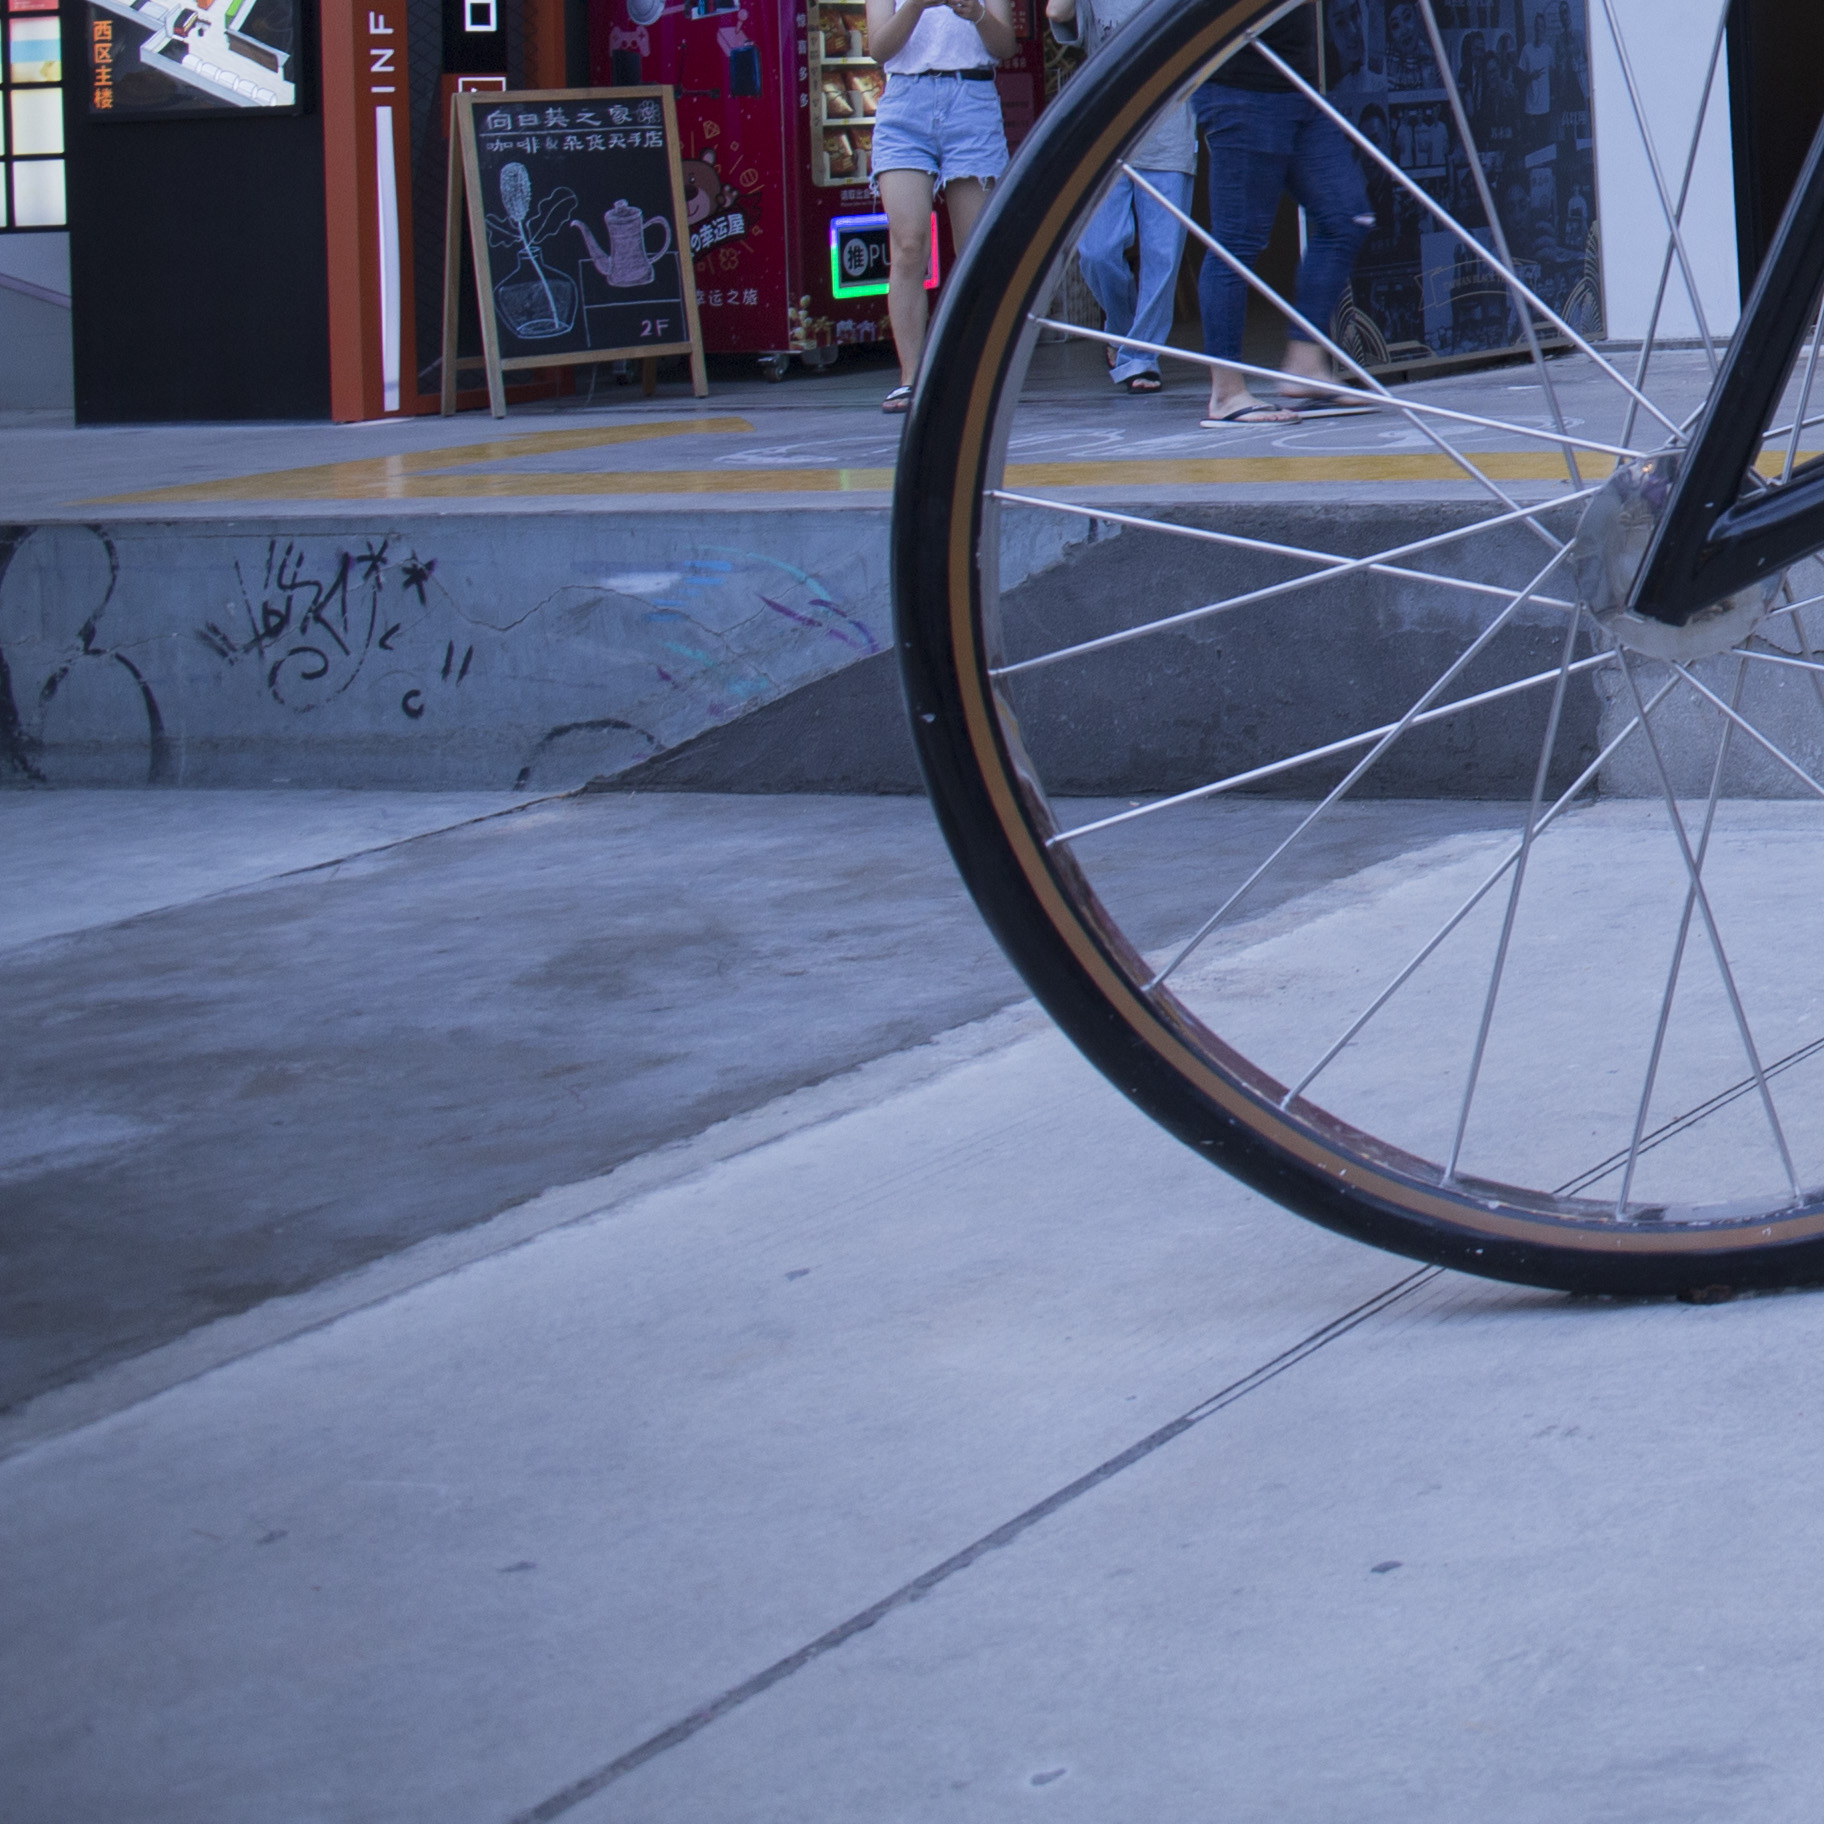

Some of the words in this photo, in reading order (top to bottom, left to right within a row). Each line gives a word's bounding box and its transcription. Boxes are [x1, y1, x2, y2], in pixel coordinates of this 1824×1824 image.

[93, 19, 114, 110] 西区主楼
[847, 245, 865, 270] 推
[640, 319, 670, 338] 2F
